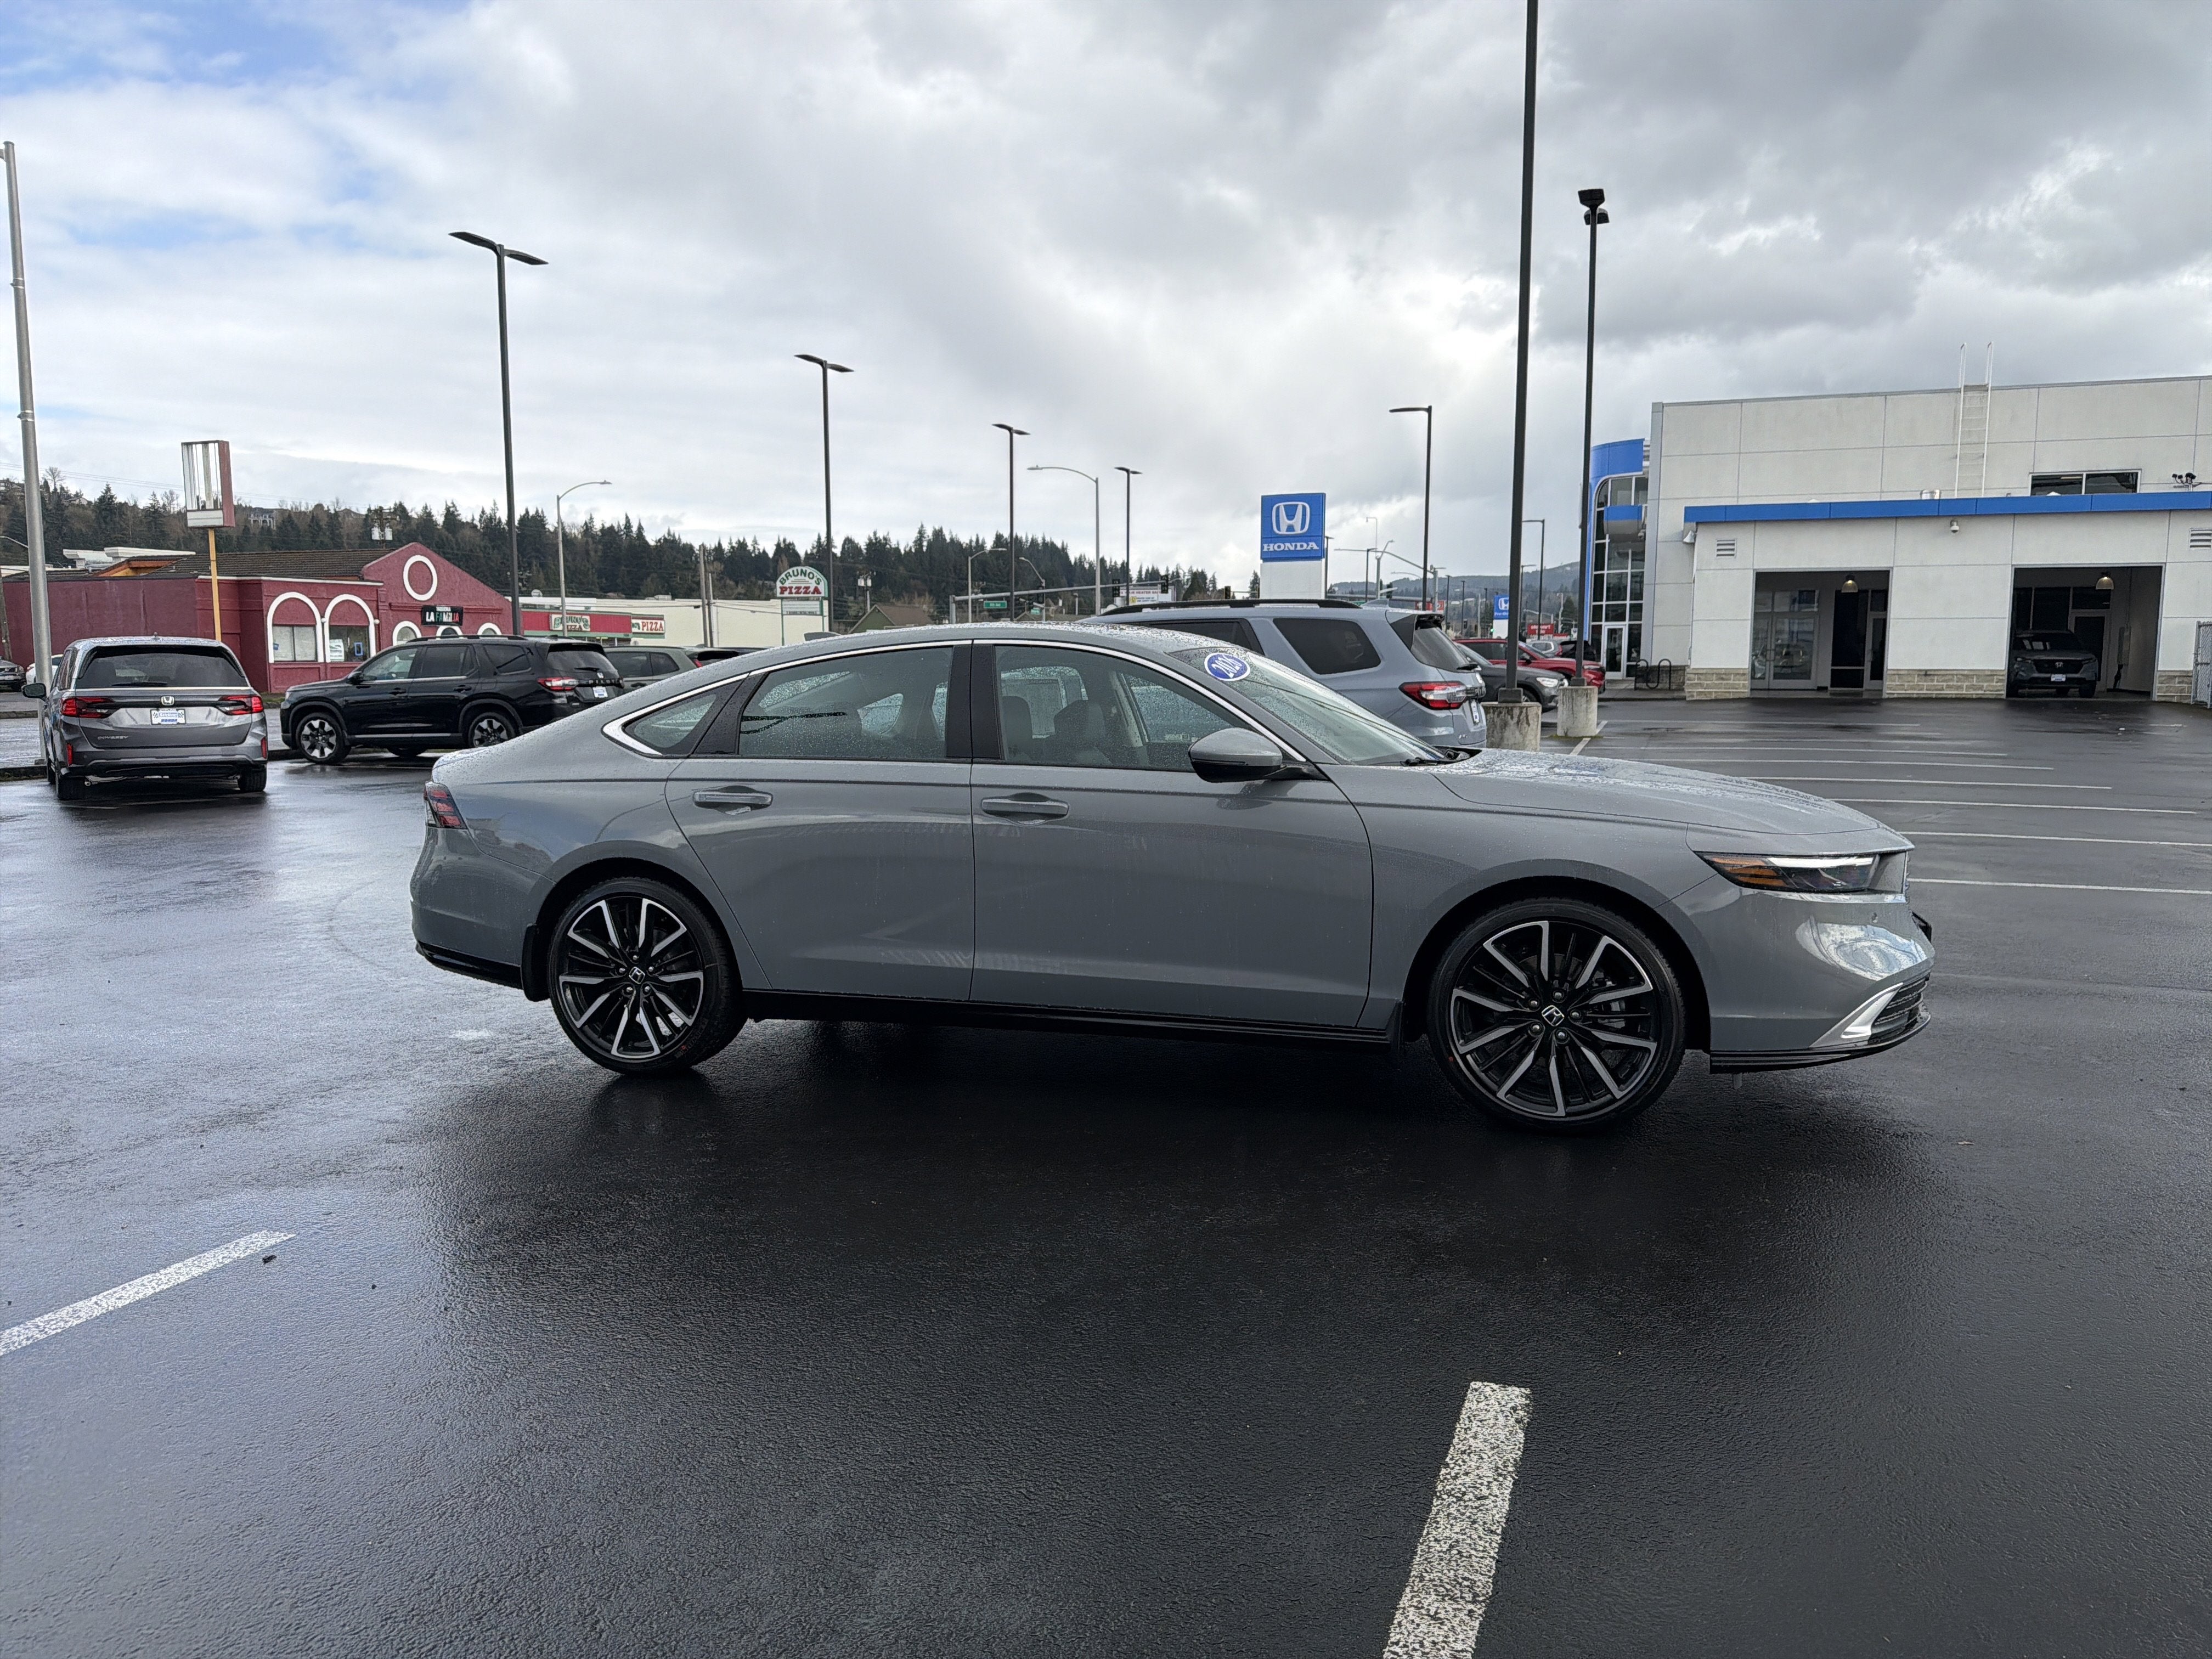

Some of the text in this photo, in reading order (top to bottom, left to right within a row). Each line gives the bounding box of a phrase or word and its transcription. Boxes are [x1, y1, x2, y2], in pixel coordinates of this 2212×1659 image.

[1263, 542, 1319, 551] HONDA
[779, 568, 822, 585] BRUNO'S
[779, 586, 822, 595] PIZZA
[426, 612, 435, 622] LA
[641, 622, 664, 631] PIZZA
[1211, 654, 1242, 678] 2026
